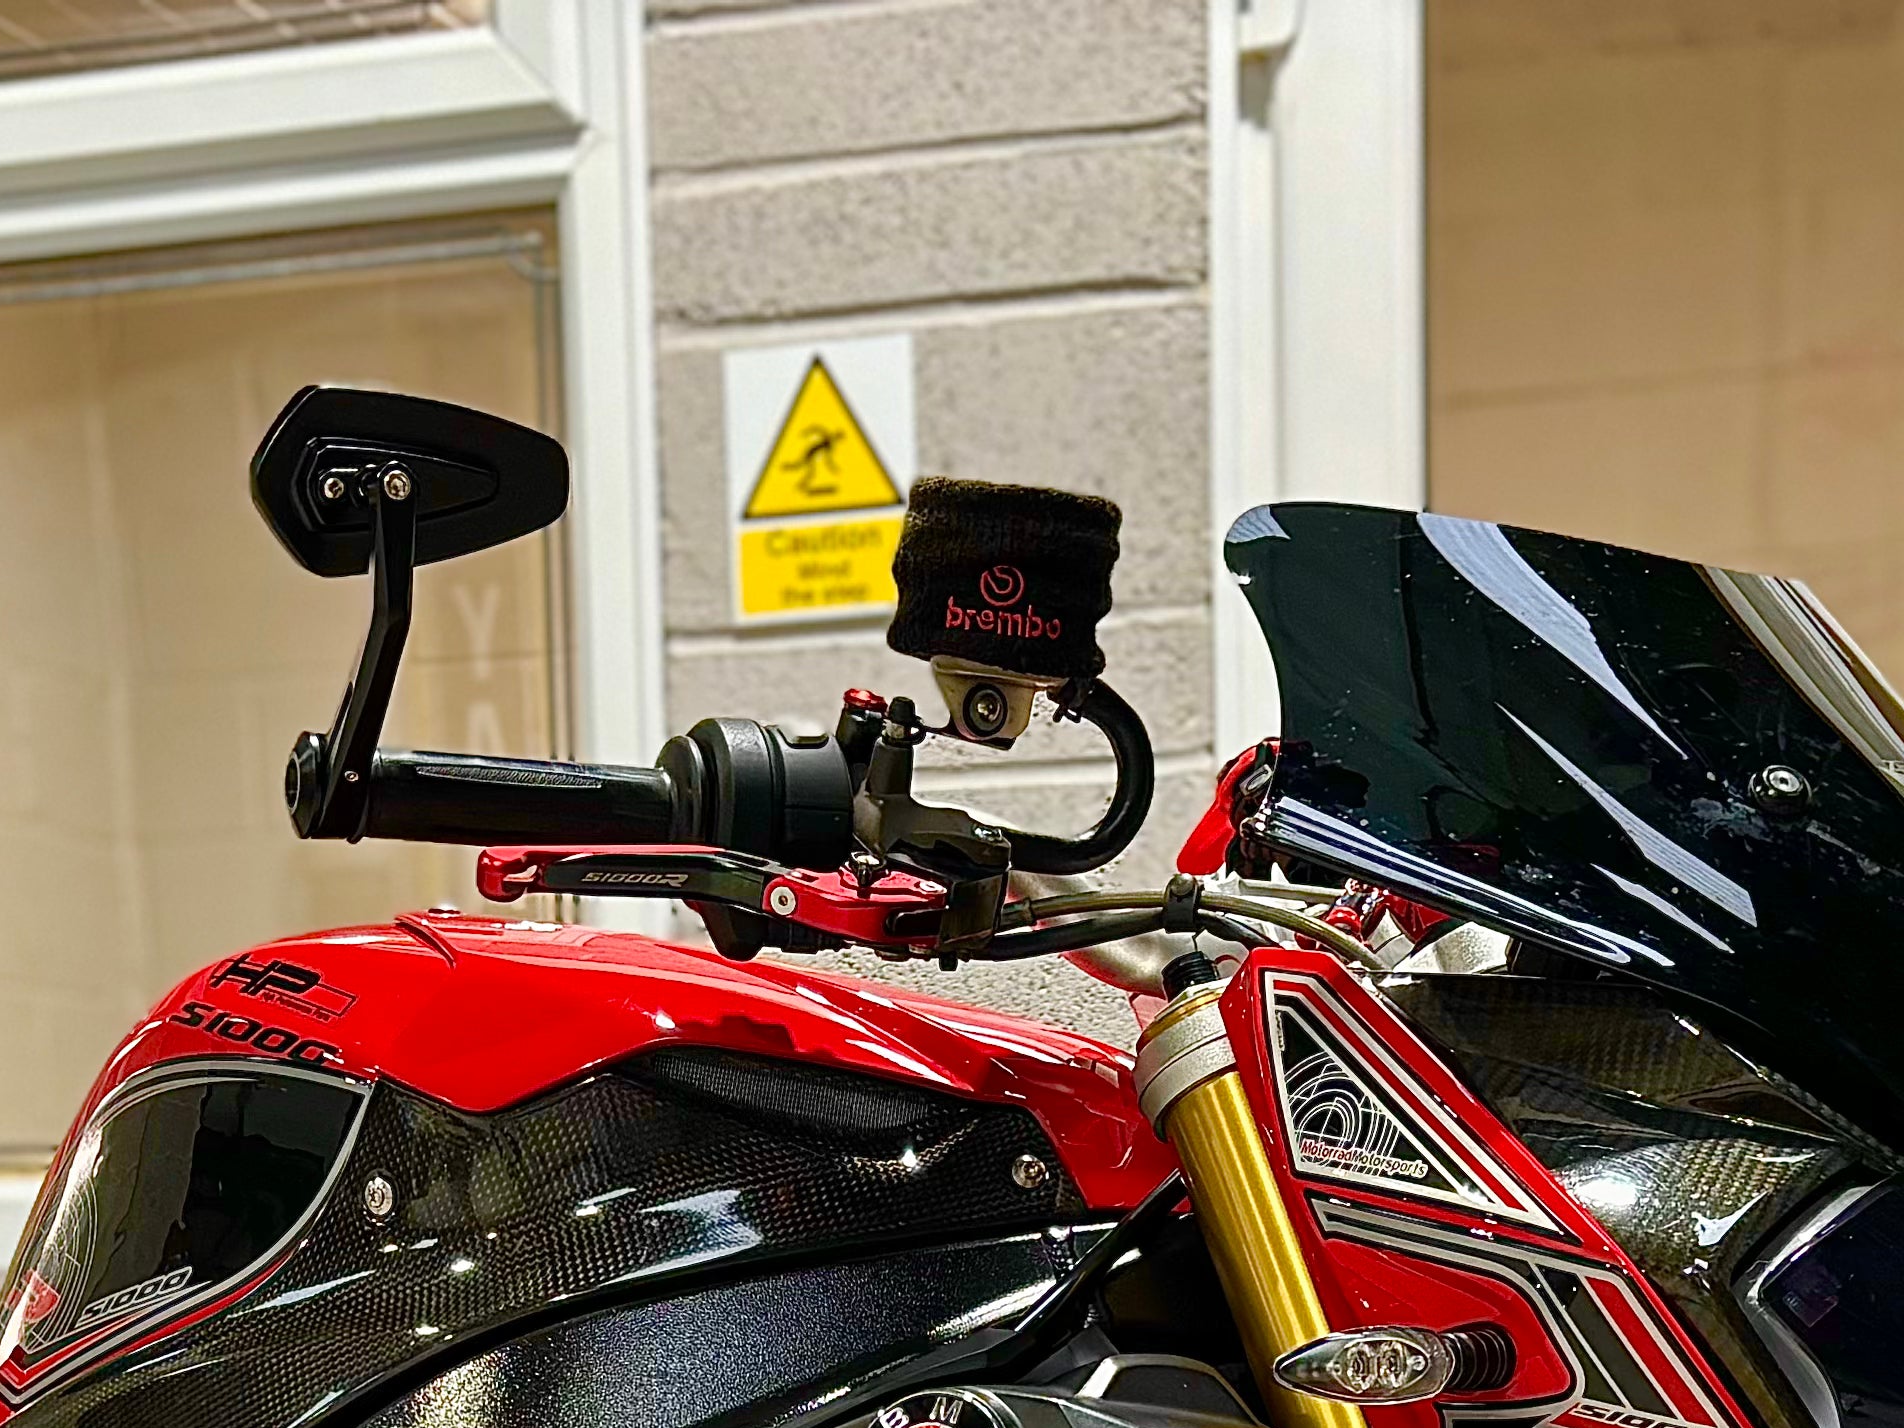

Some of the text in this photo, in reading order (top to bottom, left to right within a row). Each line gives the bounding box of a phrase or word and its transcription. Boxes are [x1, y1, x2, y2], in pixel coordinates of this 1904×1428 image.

[945, 597, 1061, 640] brembo
[581, 872, 689, 887] S1000R
[81, 1266, 192, 1319] S1000
